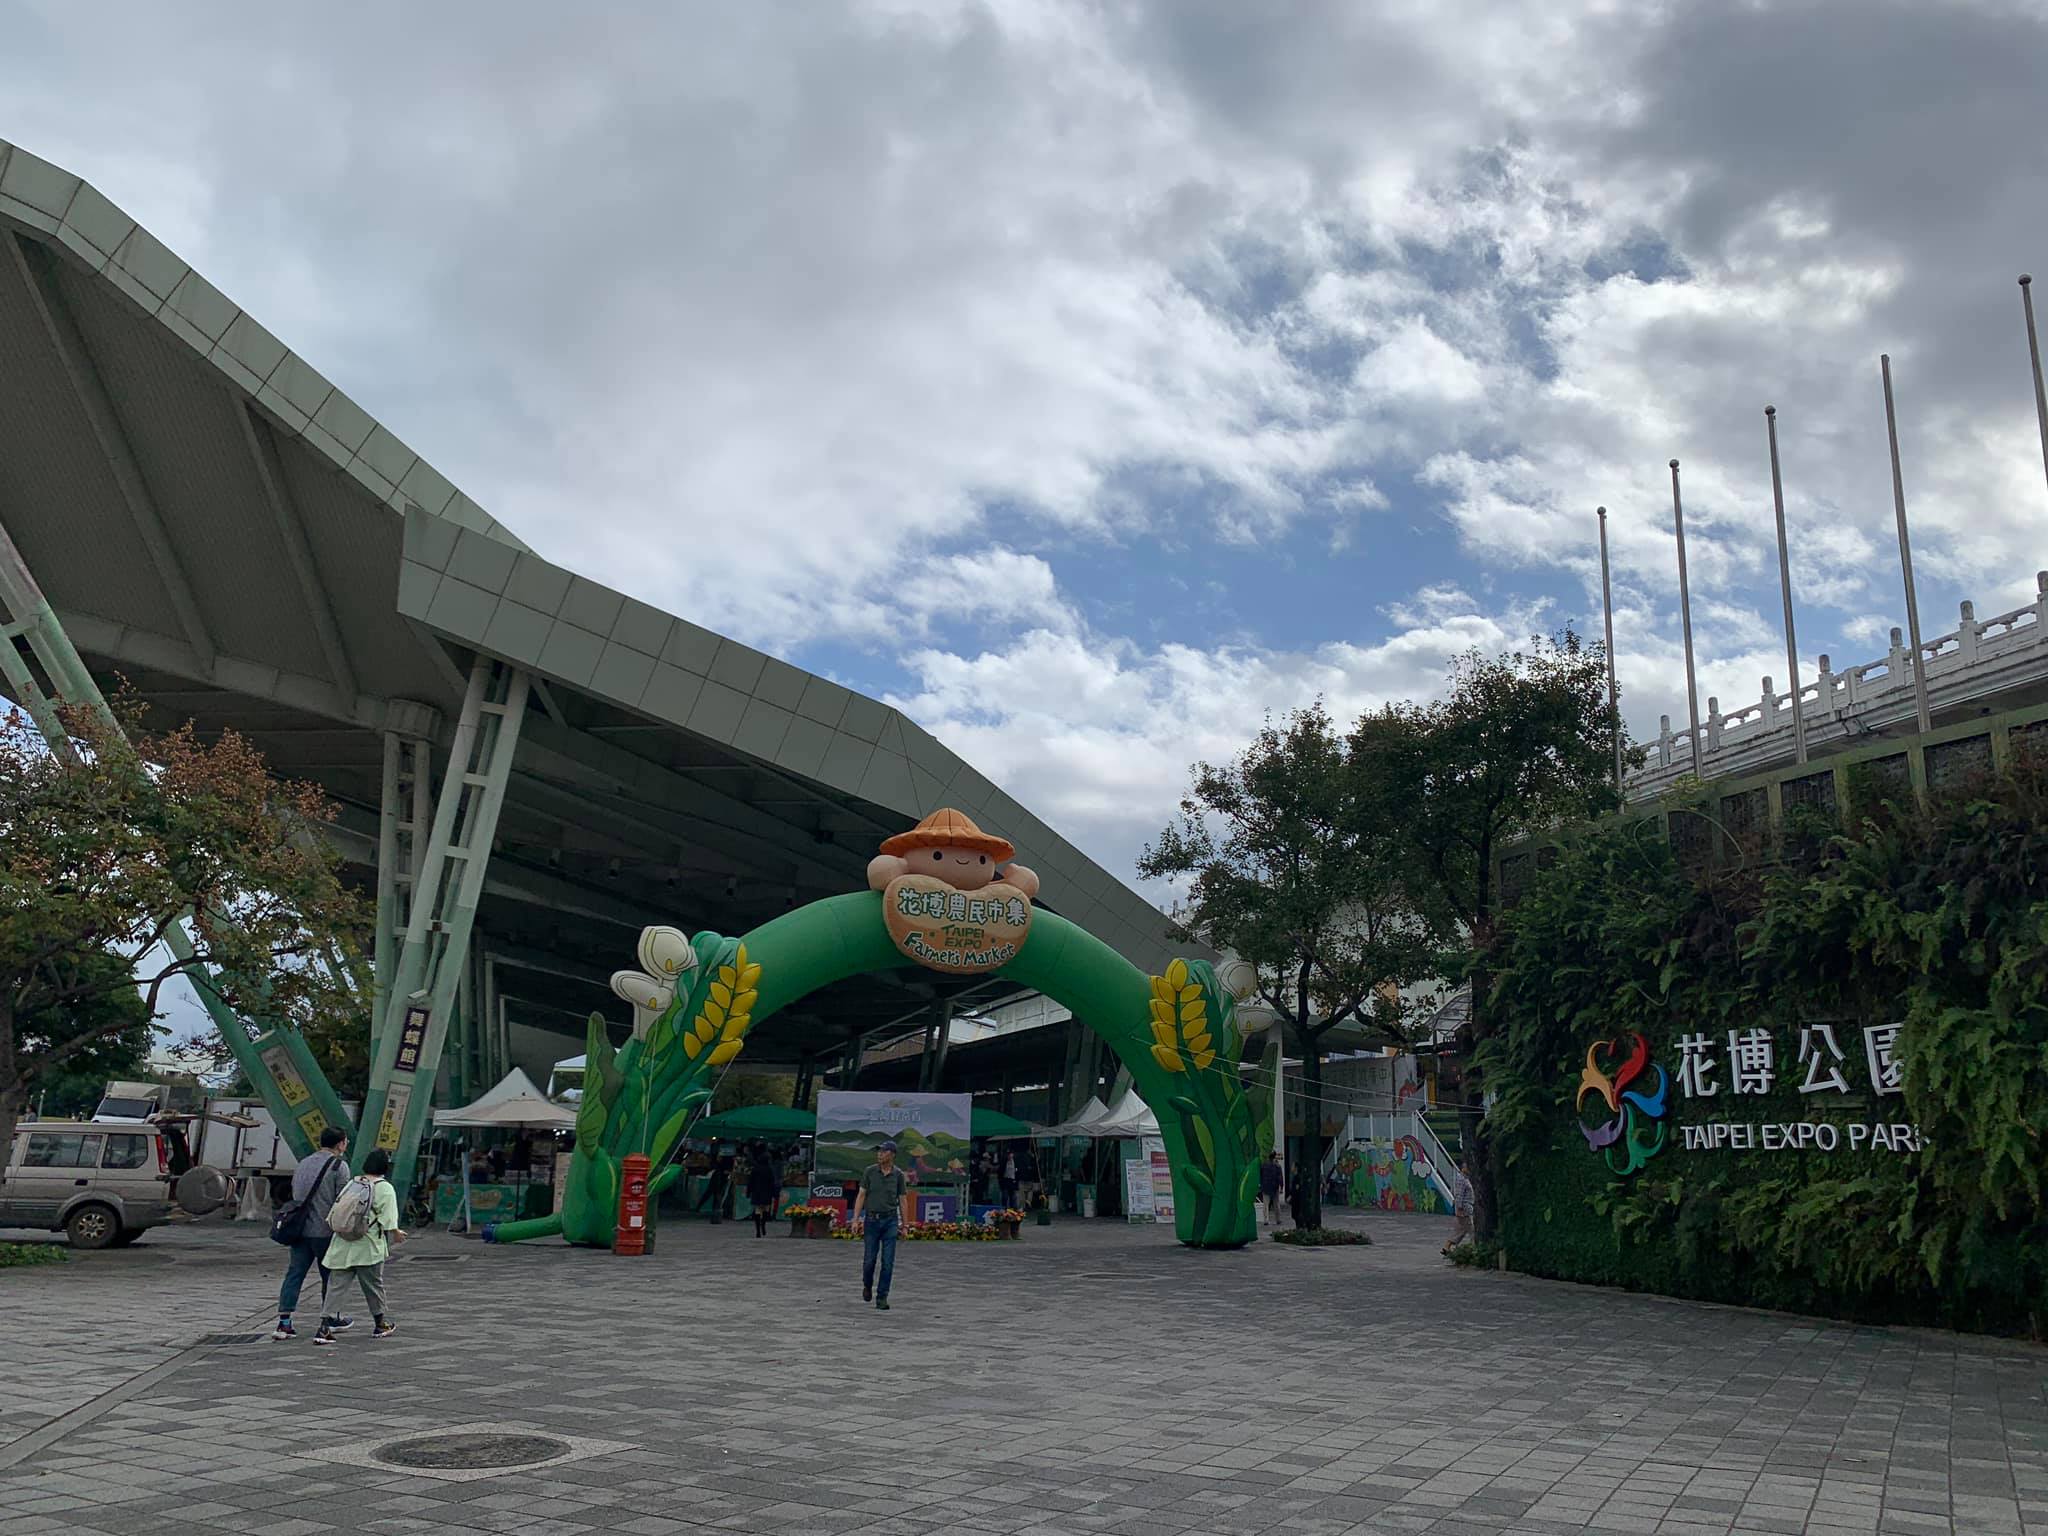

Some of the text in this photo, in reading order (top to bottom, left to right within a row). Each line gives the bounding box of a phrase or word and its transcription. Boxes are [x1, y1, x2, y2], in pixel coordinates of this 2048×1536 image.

[898, 888, 1027, 926] 花博農民市集
[941, 924, 984, 938] TAIPEI
[944, 937, 982, 948] EXPO
[963, 943, 1015, 965] Market
[1680, 1123, 1755, 1150] TAIPEI
[1761, 1122, 1839, 1151] EXPO
